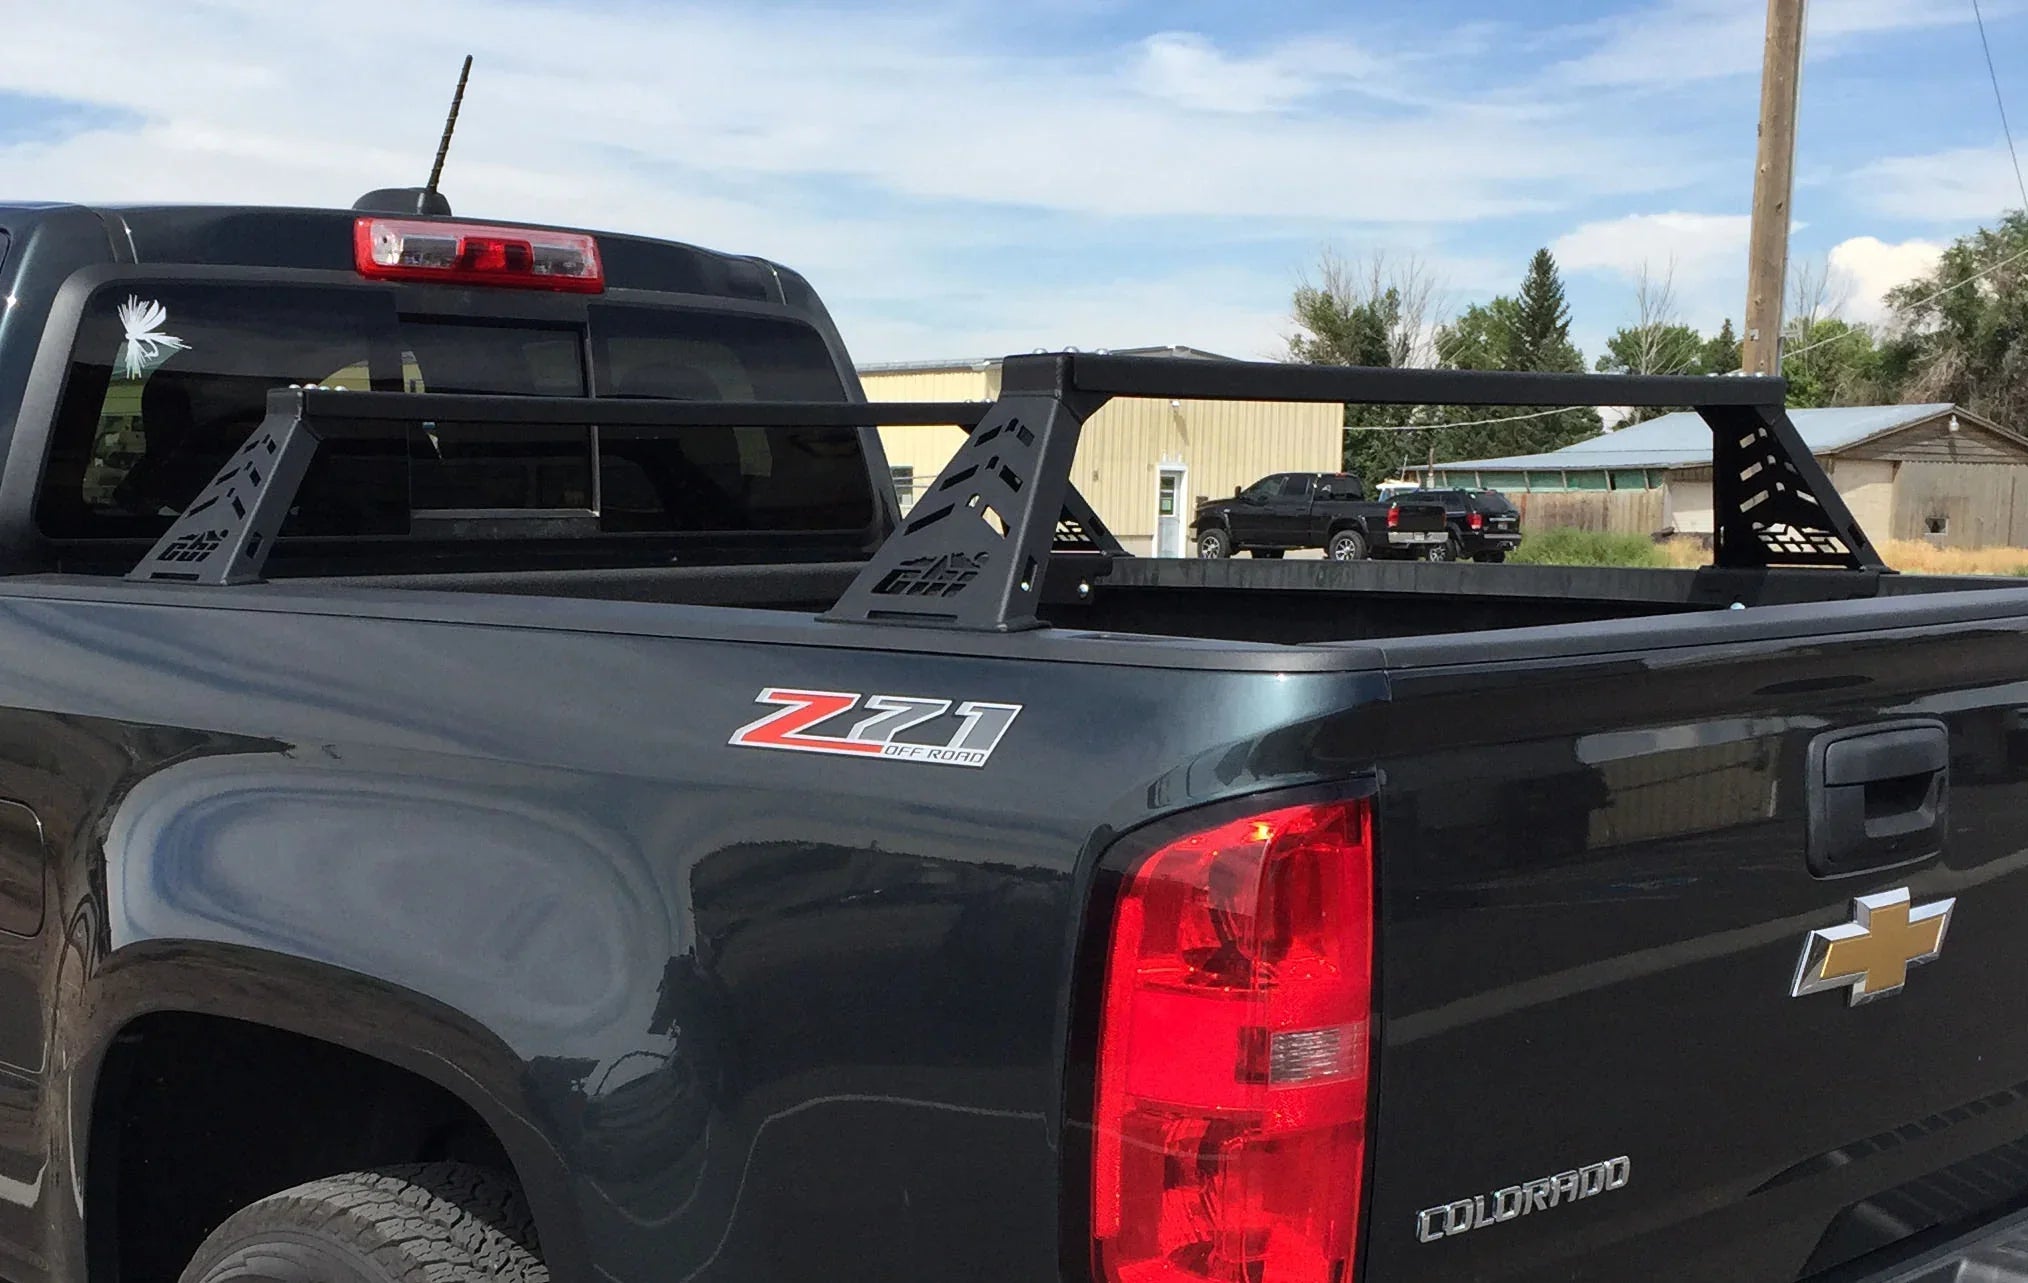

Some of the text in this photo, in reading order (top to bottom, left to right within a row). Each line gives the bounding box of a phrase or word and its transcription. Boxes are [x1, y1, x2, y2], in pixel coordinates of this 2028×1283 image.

[727, 687, 1022, 757] Z71
[884, 745, 985, 764] OFF ROAD
[1415, 1155, 1631, 1244] COLORADO
